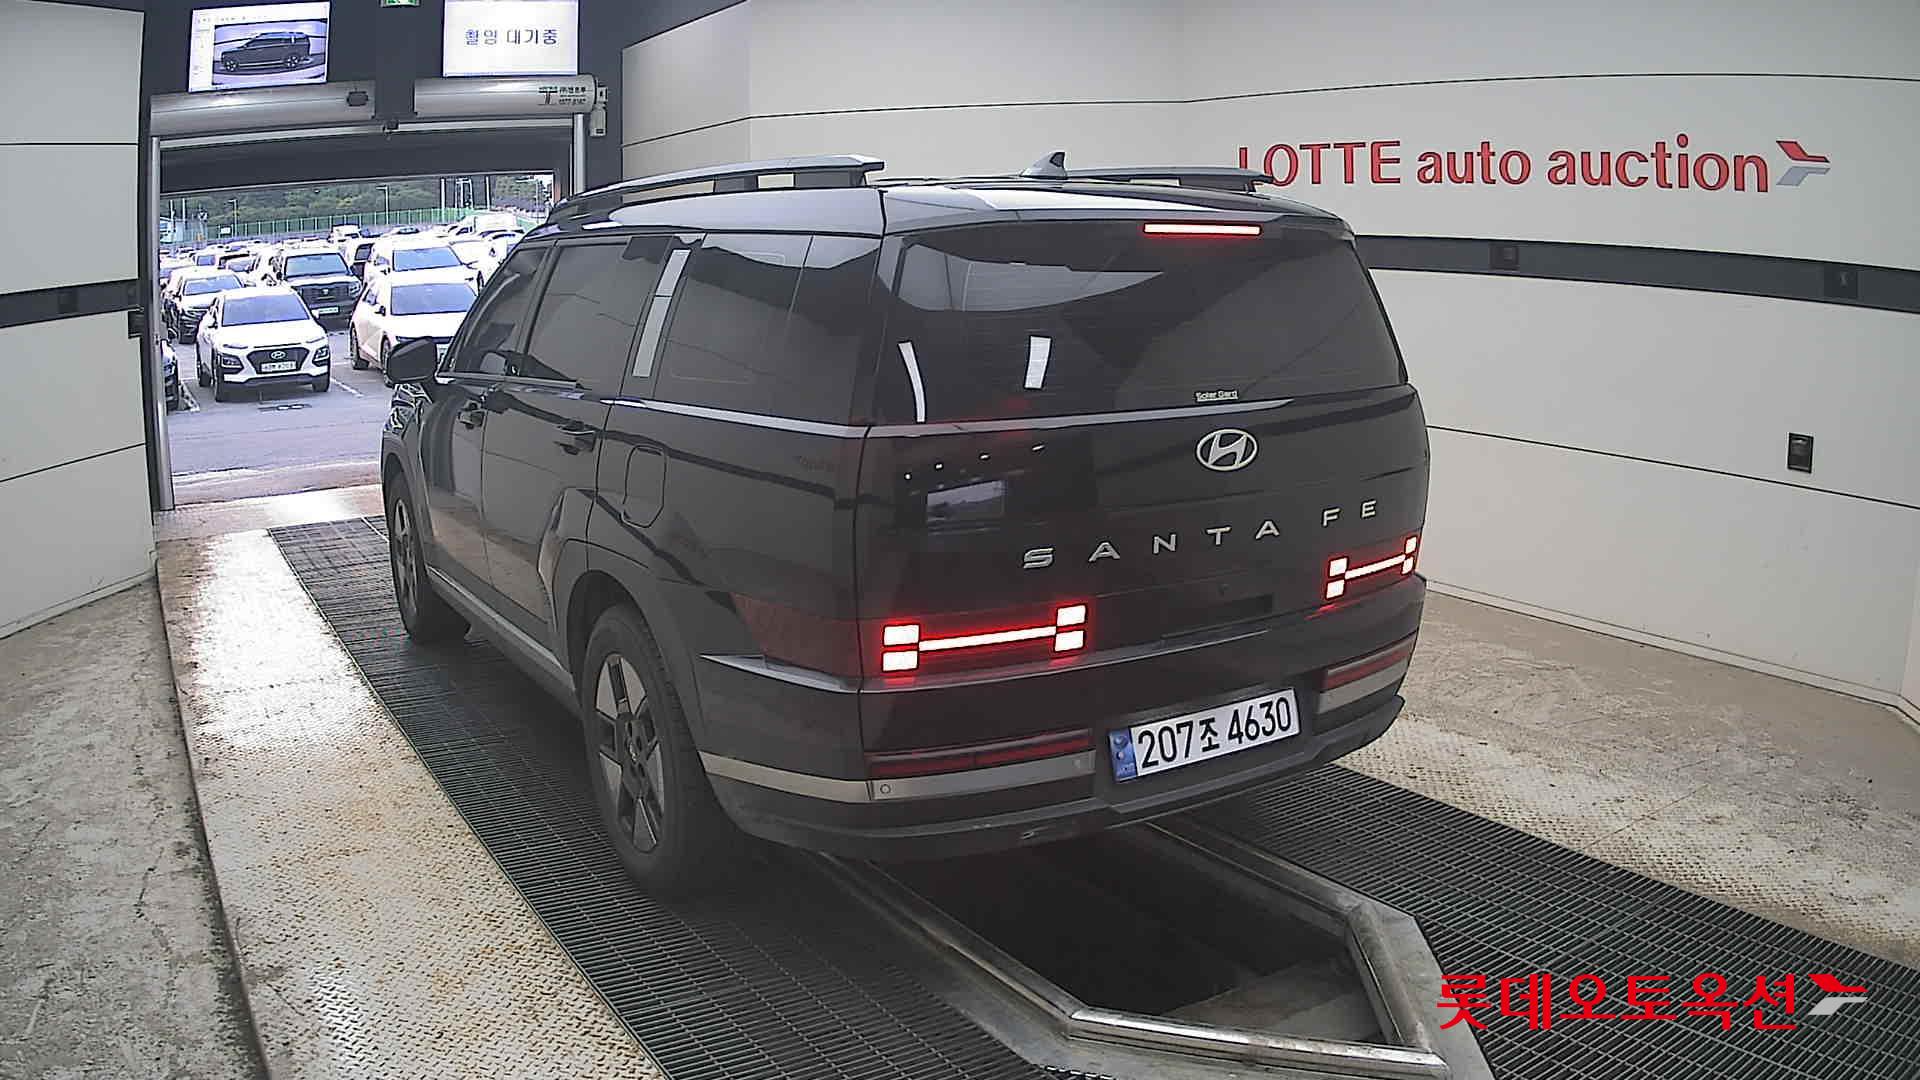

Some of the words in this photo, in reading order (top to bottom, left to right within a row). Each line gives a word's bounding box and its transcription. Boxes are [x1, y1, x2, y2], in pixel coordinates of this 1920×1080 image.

[506, 29, 558, 45] 대기중
[1416, 141, 1531, 185] auto
[1548, 133, 1768, 193] auction
[1023, 520, 1281, 569] SANTA
[1321, 499, 1377, 527] FE
[1138, 717, 1220, 769] 207조
[1227, 696, 1292, 745] 4630
